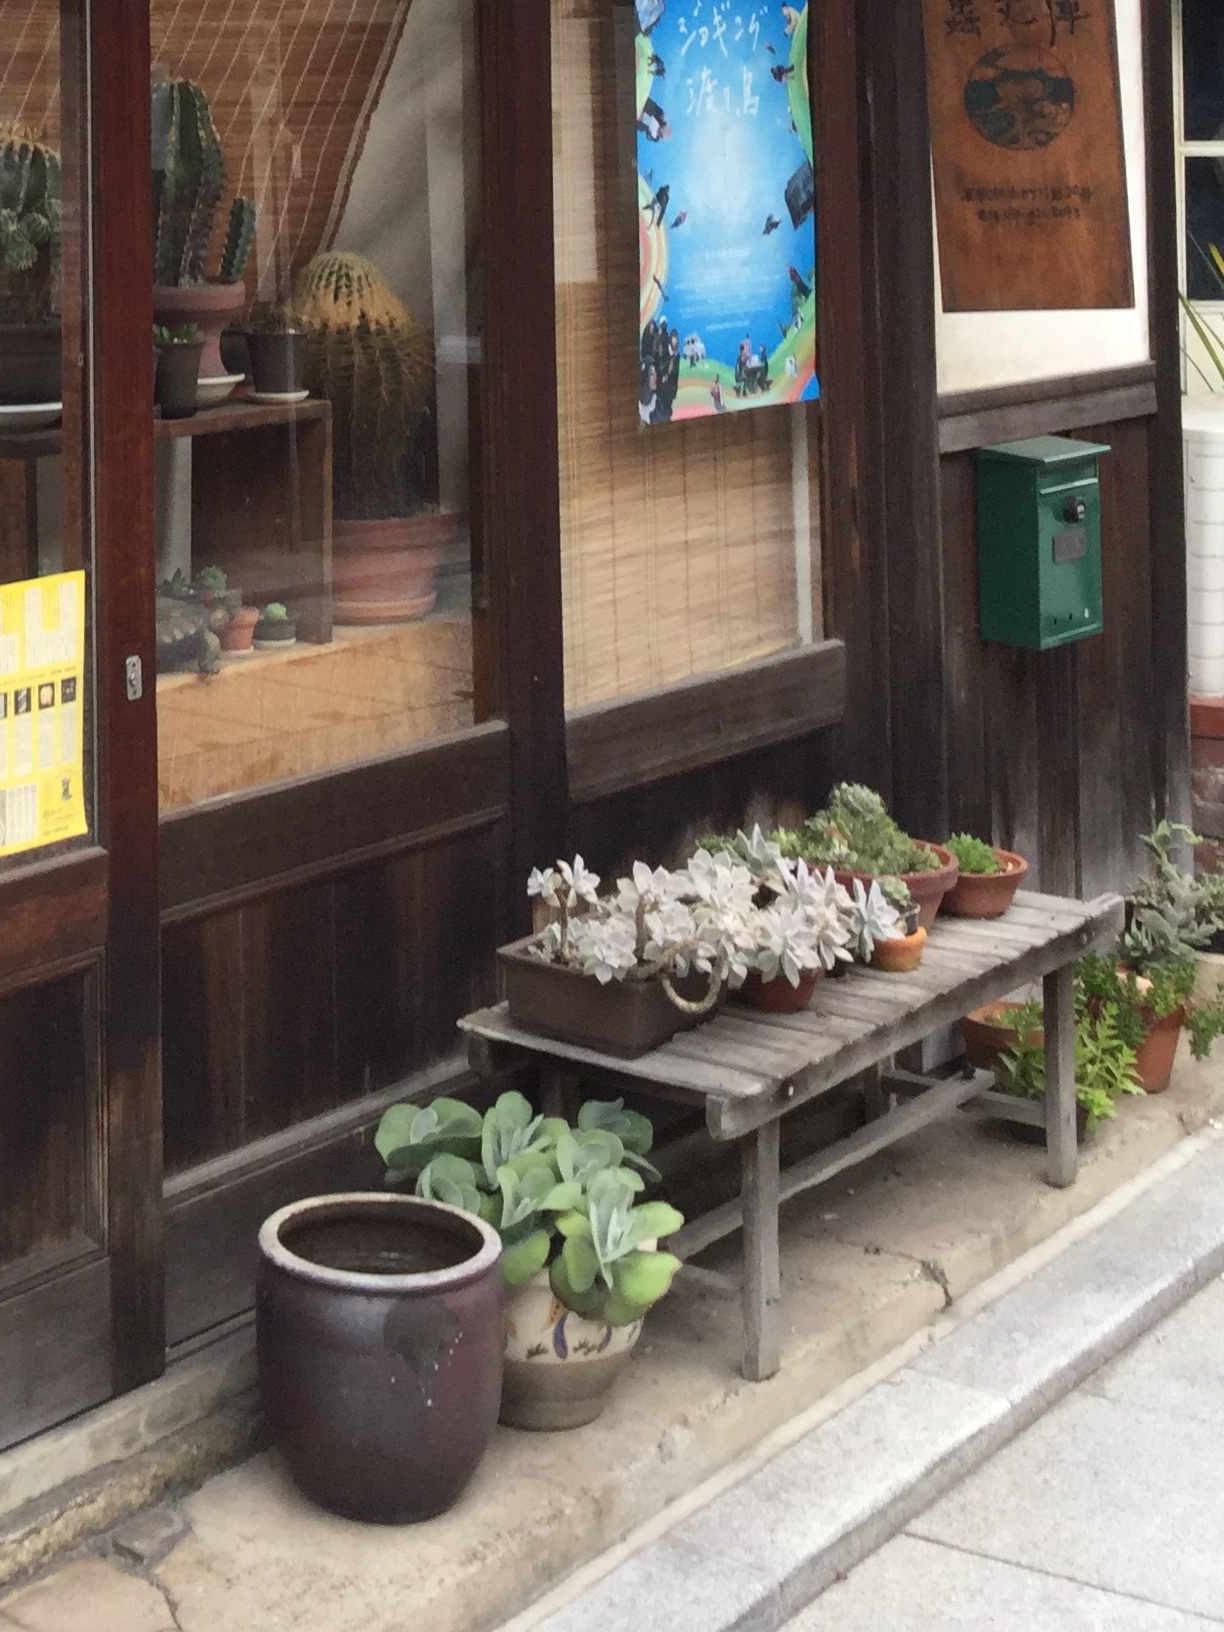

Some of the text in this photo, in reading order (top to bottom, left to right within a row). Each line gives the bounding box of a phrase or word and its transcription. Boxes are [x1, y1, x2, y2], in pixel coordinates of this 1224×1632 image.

[678, 0, 769, 58] ジョギング
[686, 65, 761, 118] 渡り鳥
